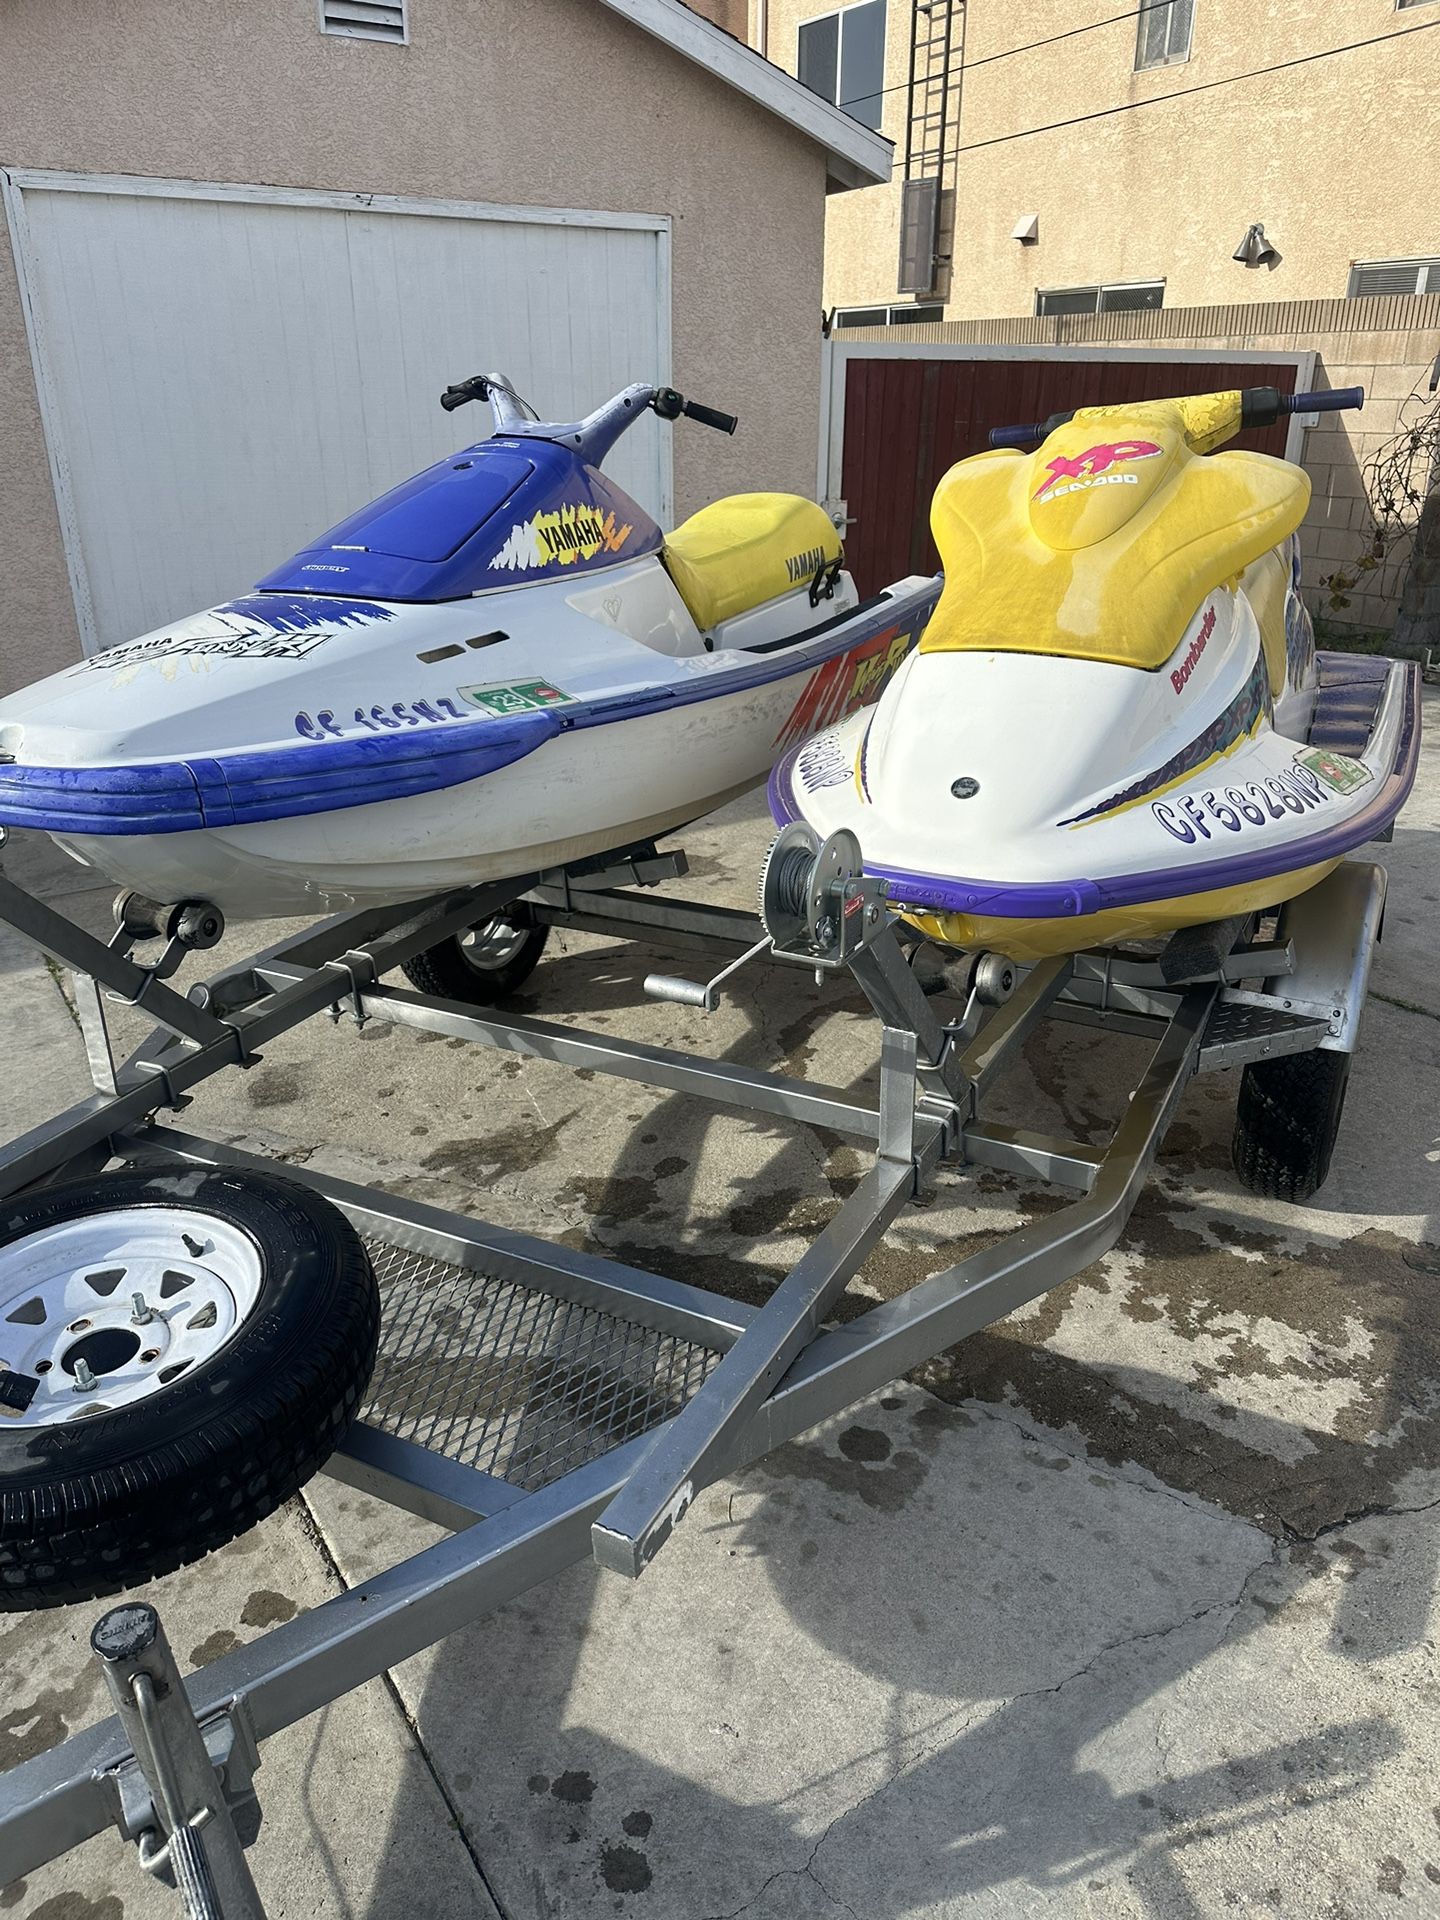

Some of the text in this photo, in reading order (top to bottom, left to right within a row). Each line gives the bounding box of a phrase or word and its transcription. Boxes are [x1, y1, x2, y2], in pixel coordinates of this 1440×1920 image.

[538, 508, 606, 553] YAMAHA
[785, 545, 826, 583] YAMAHA
[1170, 605, 1216, 695] Bombardier
[294, 711, 345, 740] CF
[1151, 764, 1328, 844] CF5828NP
